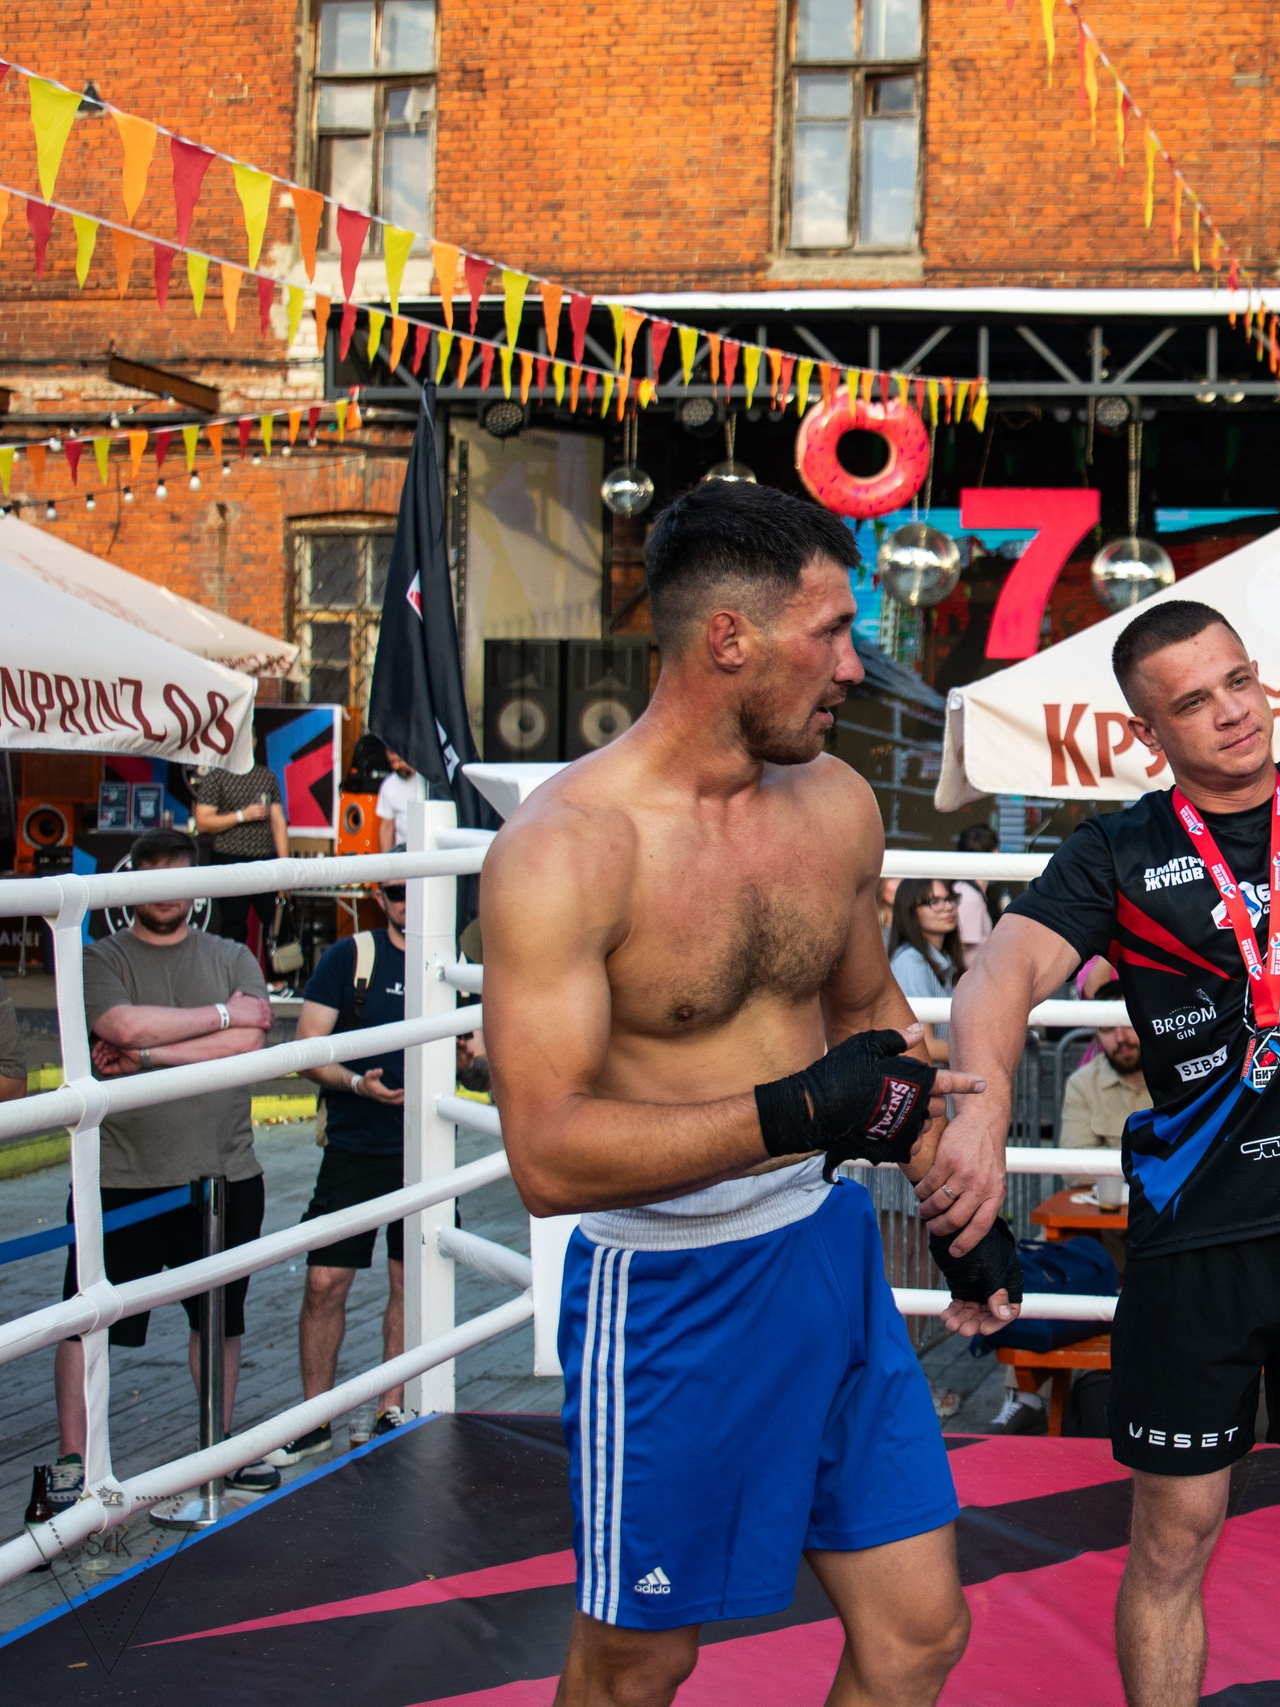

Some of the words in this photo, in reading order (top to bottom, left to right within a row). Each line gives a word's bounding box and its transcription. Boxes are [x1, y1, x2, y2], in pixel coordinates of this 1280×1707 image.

[960, 487, 1101, 659] 7
[0, 666, 167, 743] NPRINZ
[1143, 856, 1206, 879] ДМИТРИ
[1144, 866, 1205, 892] ЖУКОВ
[1152, 1005, 1217, 1036] BROOM
[1176, 1028, 1196, 1040] GIN
[868, 1080, 911, 1135] TWINS
[1128, 1421, 1239, 1449] VESET
